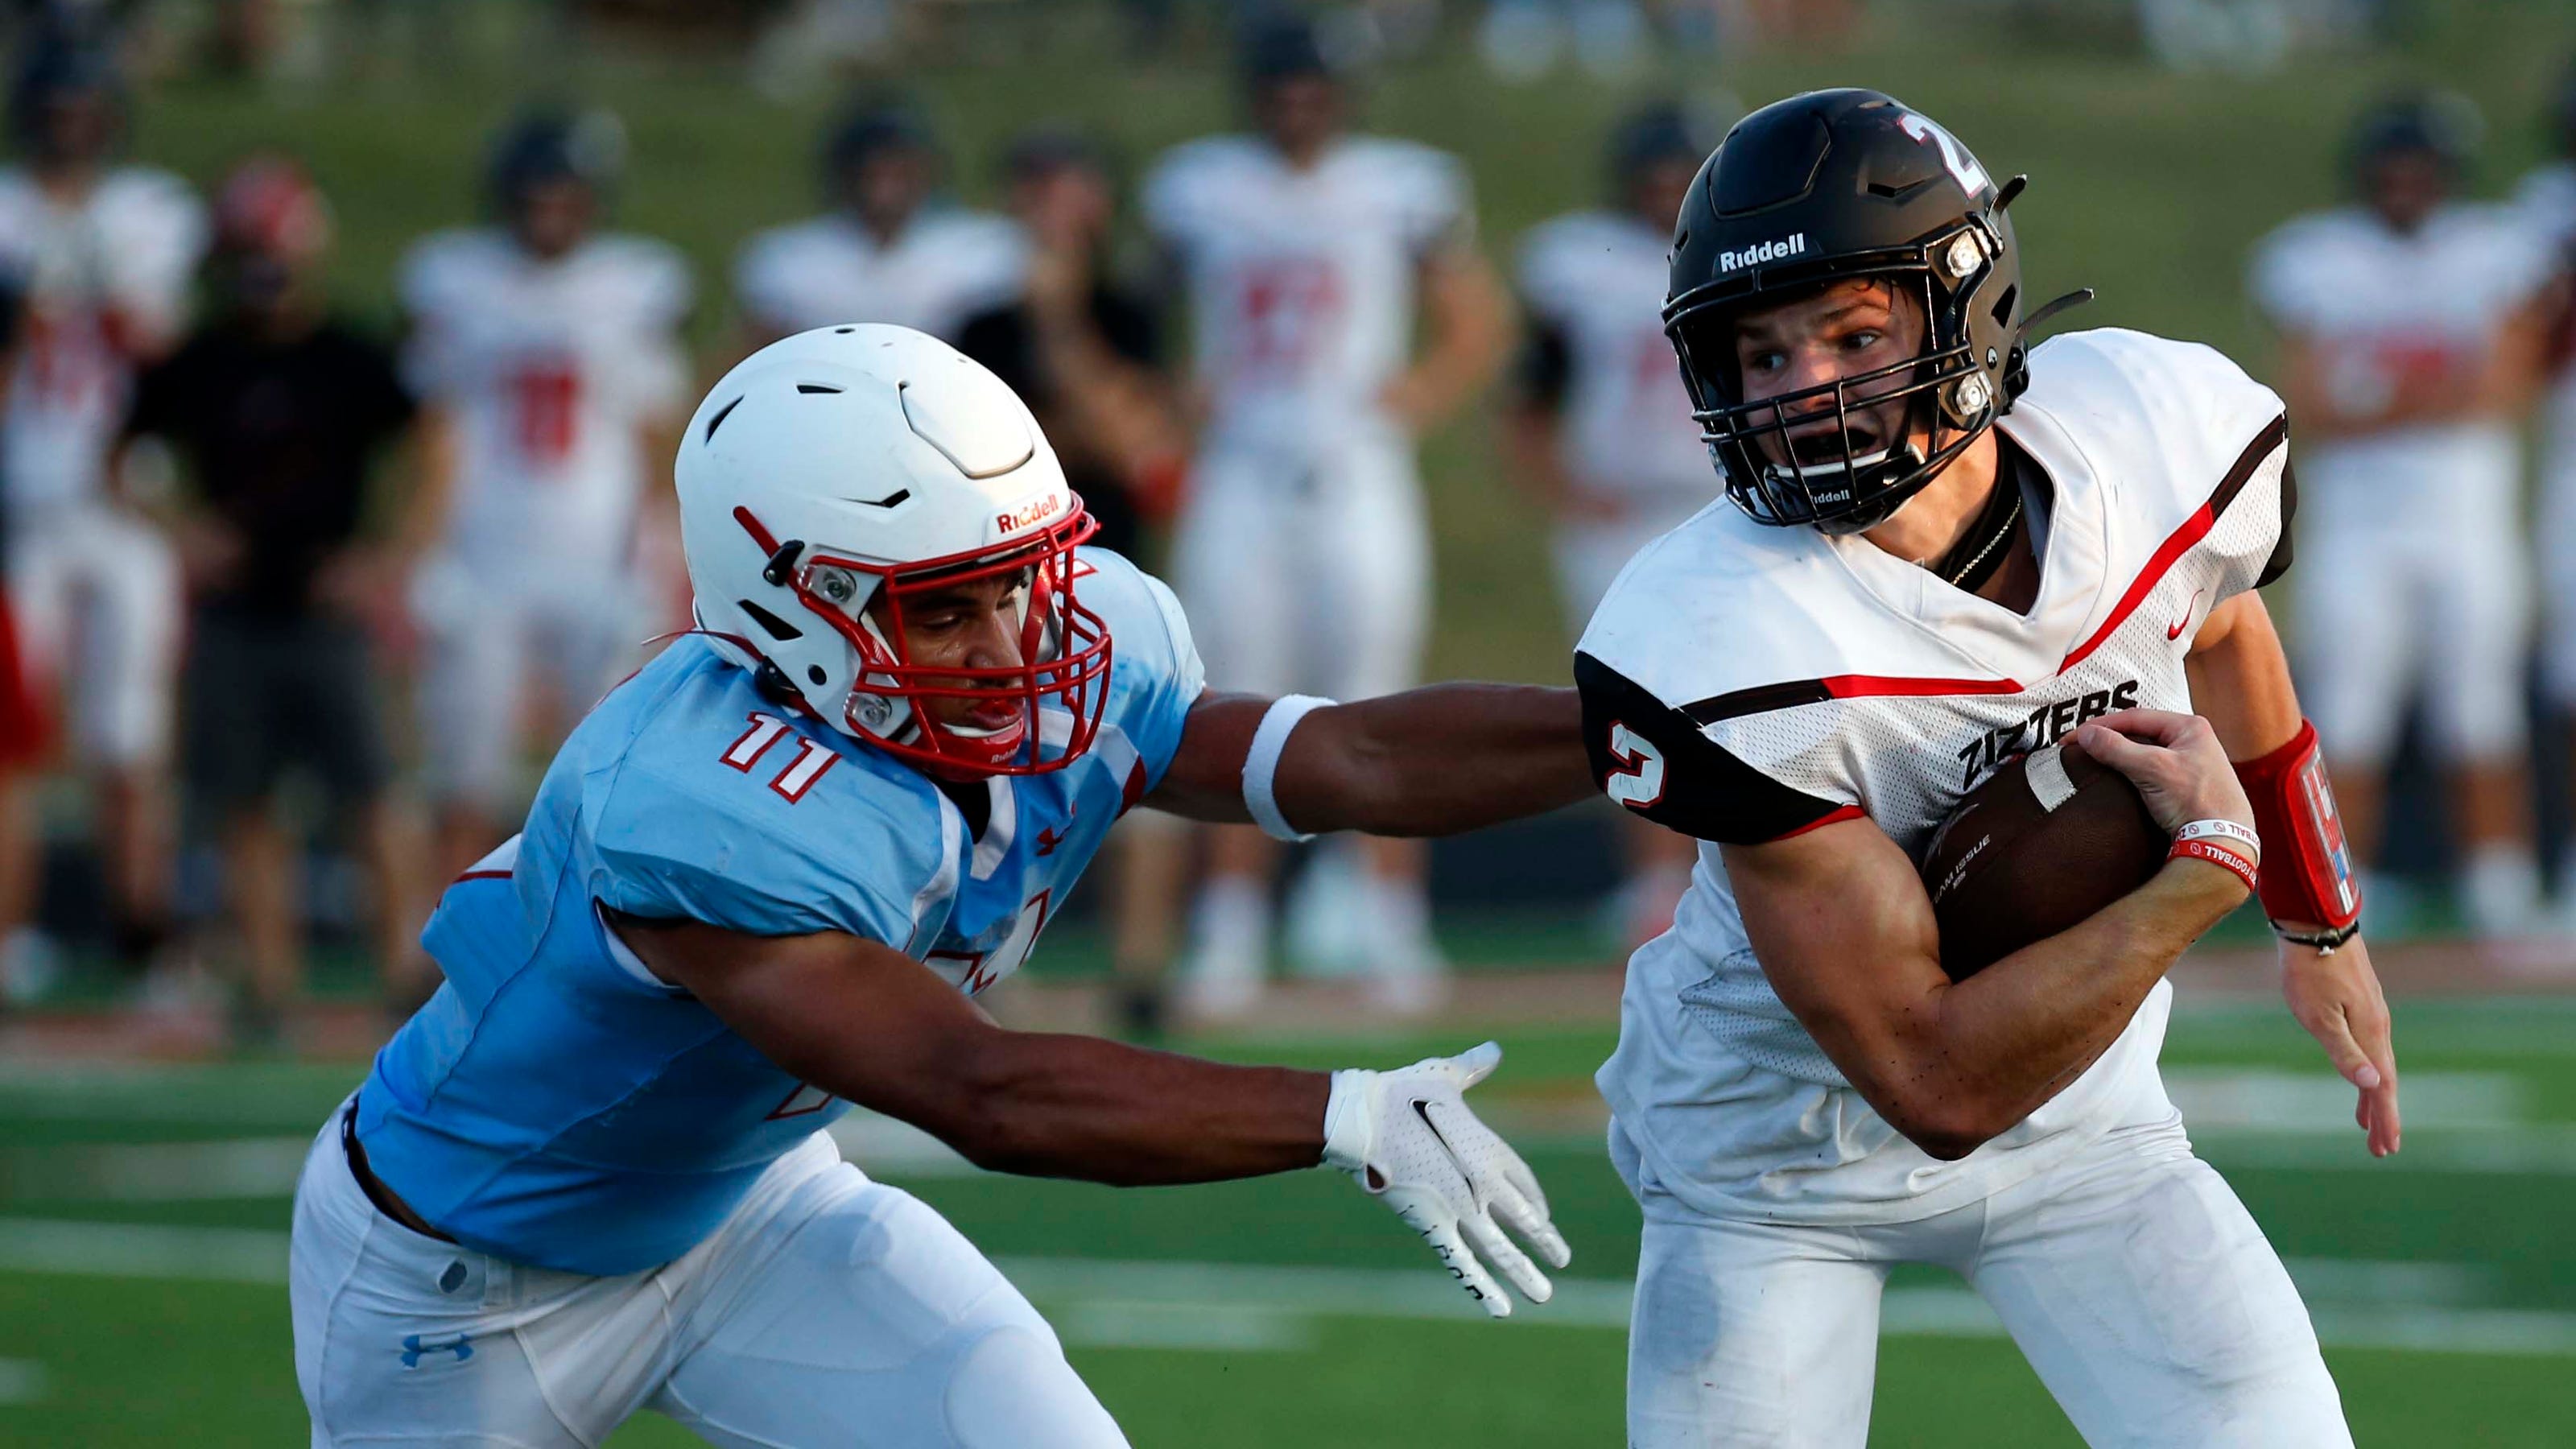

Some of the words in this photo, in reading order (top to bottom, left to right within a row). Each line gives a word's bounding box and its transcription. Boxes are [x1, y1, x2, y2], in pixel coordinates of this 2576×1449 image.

[1895, 110, 1988, 199] 2
[1719, 233, 1806, 274] Riddell
[997, 493, 1059, 535] Riddell
[1809, 489, 1851, 506] iddell
[719, 711, 843, 806] 11
[1605, 718, 1669, 808] 2
[1933, 870, 1955, 904] EAM
[1955, 833, 1992, 874] ISSUE
[2204, 844, 2252, 876] FOOTBALL
